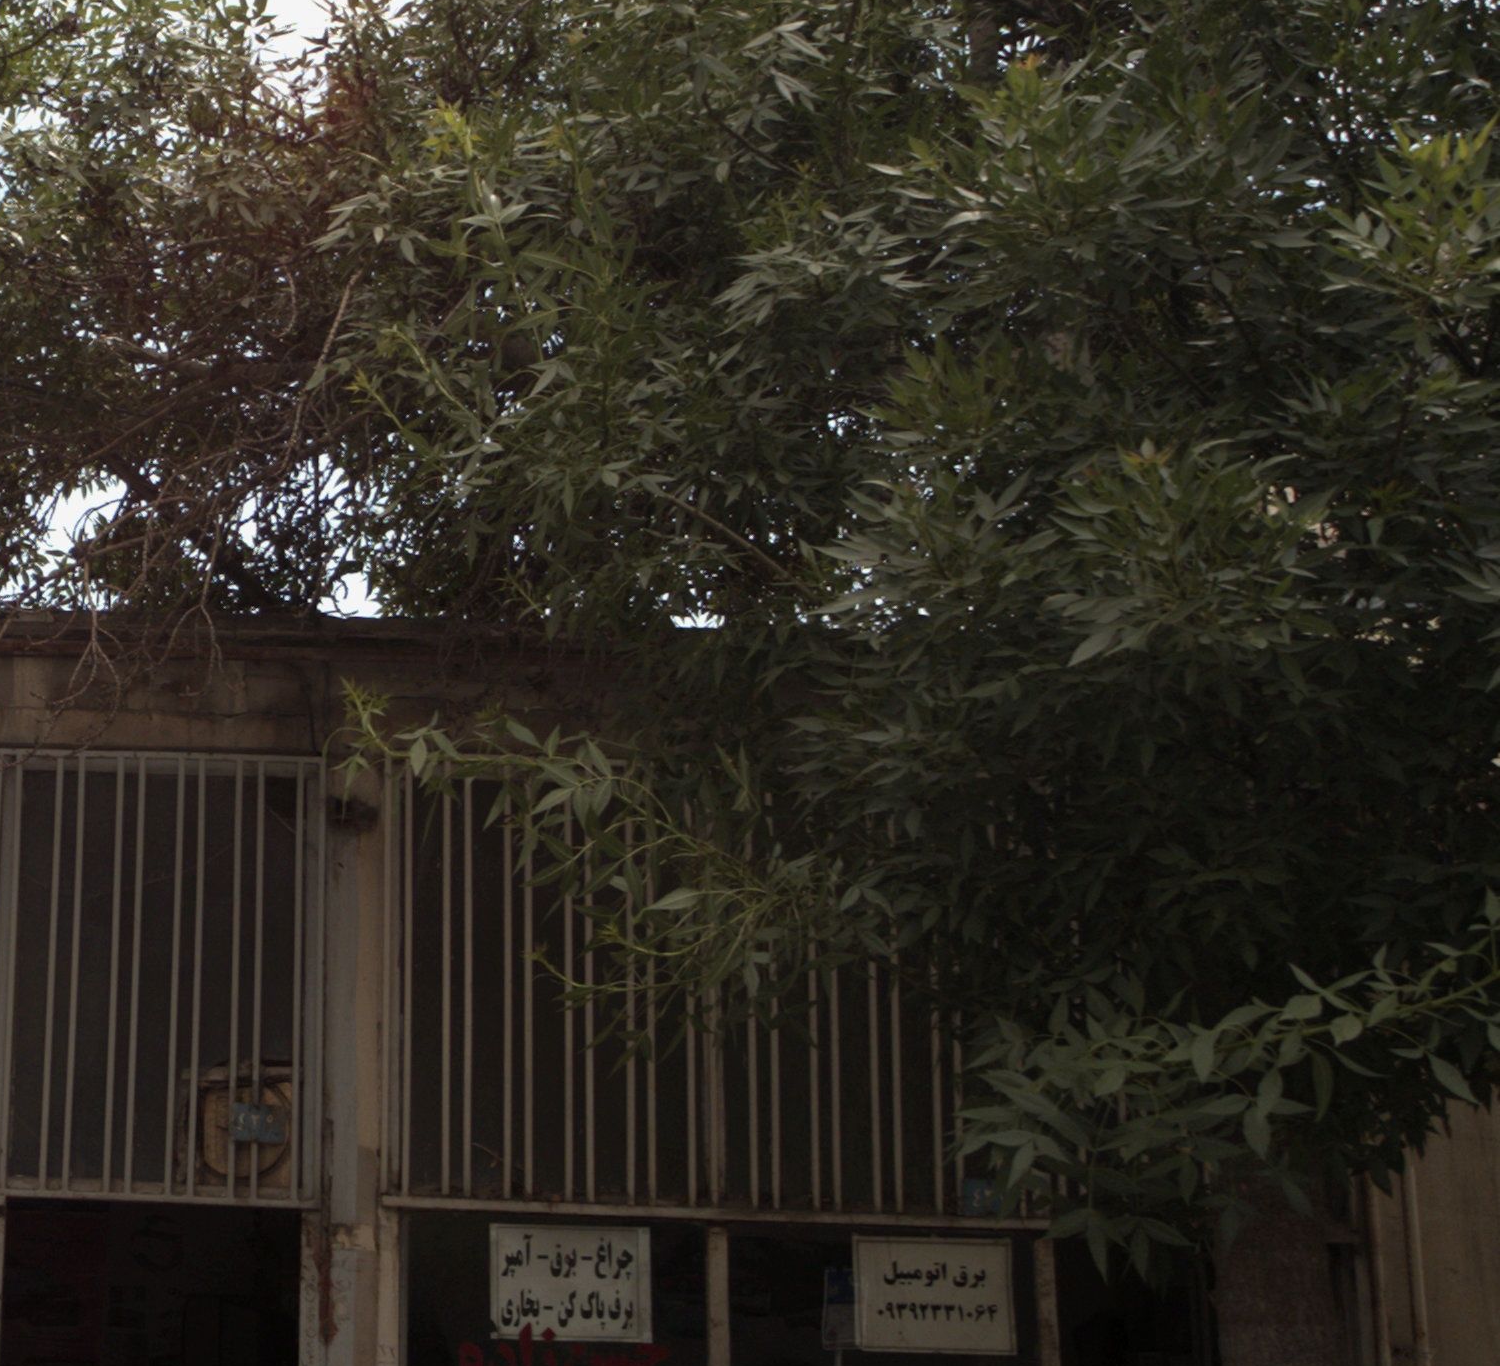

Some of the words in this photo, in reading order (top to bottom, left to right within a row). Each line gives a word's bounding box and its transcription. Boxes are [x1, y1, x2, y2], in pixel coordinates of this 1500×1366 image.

[502, 1234, 534, 1277] آمپر
[596, 1237, 634, 1280] چراغ
[884, 1261, 947, 1287] اتومبیل
[953, 1265, 986, 1289] برق
[501, 1289, 540, 1327] بخاری
[558, 1290, 577, 1327] کن
[581, 1290, 606, 1330] پاک
[608, 1290, 634, 1330] برف
[877, 1302, 999, 1321] ۰۹۳۹۲۳۳۱۰۶۴
